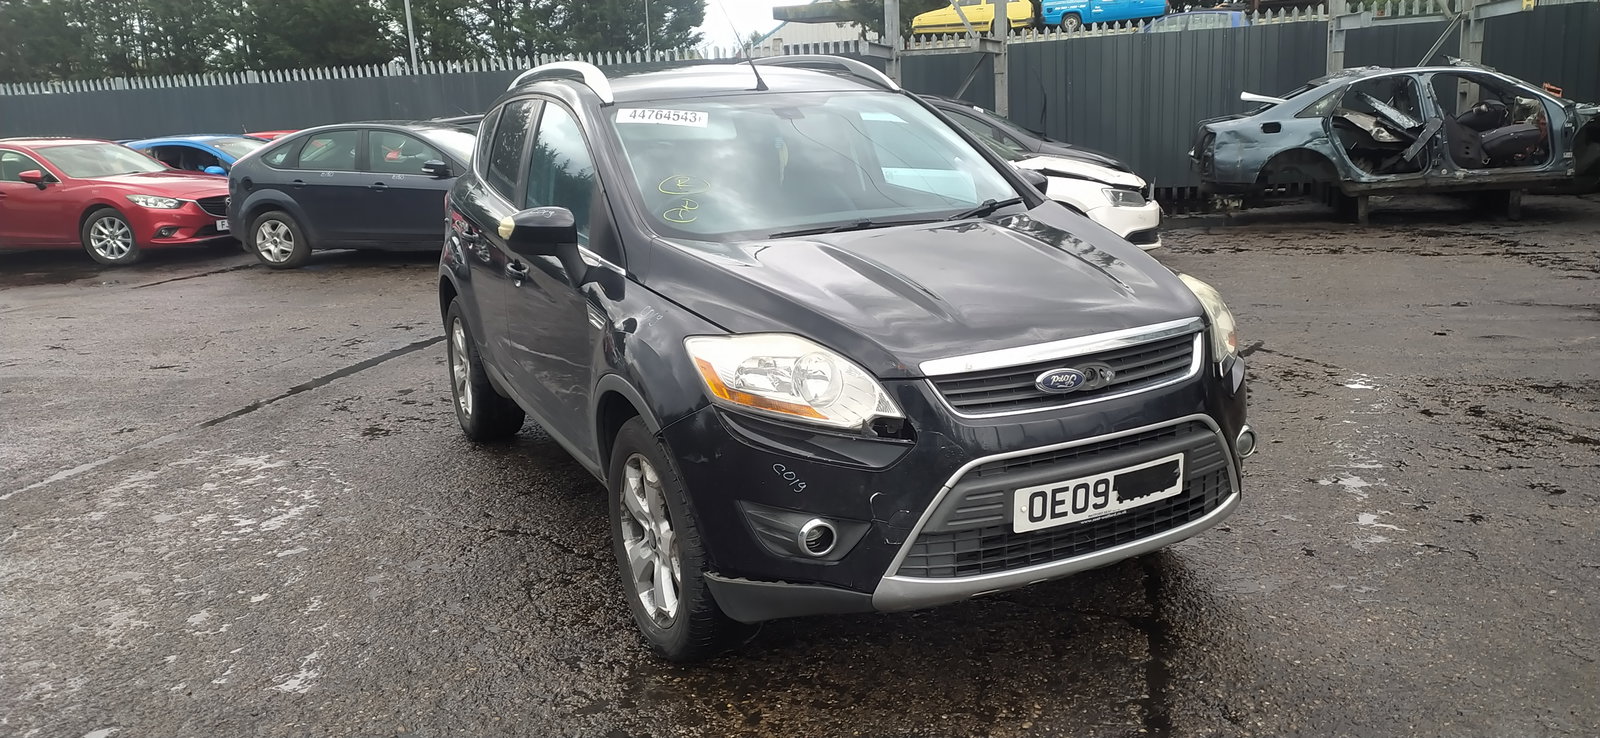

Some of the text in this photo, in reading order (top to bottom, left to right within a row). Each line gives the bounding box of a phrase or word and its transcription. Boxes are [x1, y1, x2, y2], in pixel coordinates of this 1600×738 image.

[629, 109, 697, 123] 44764543
[1050, 373, 1077, 388] Ford
[1028, 478, 1110, 523] OE09
